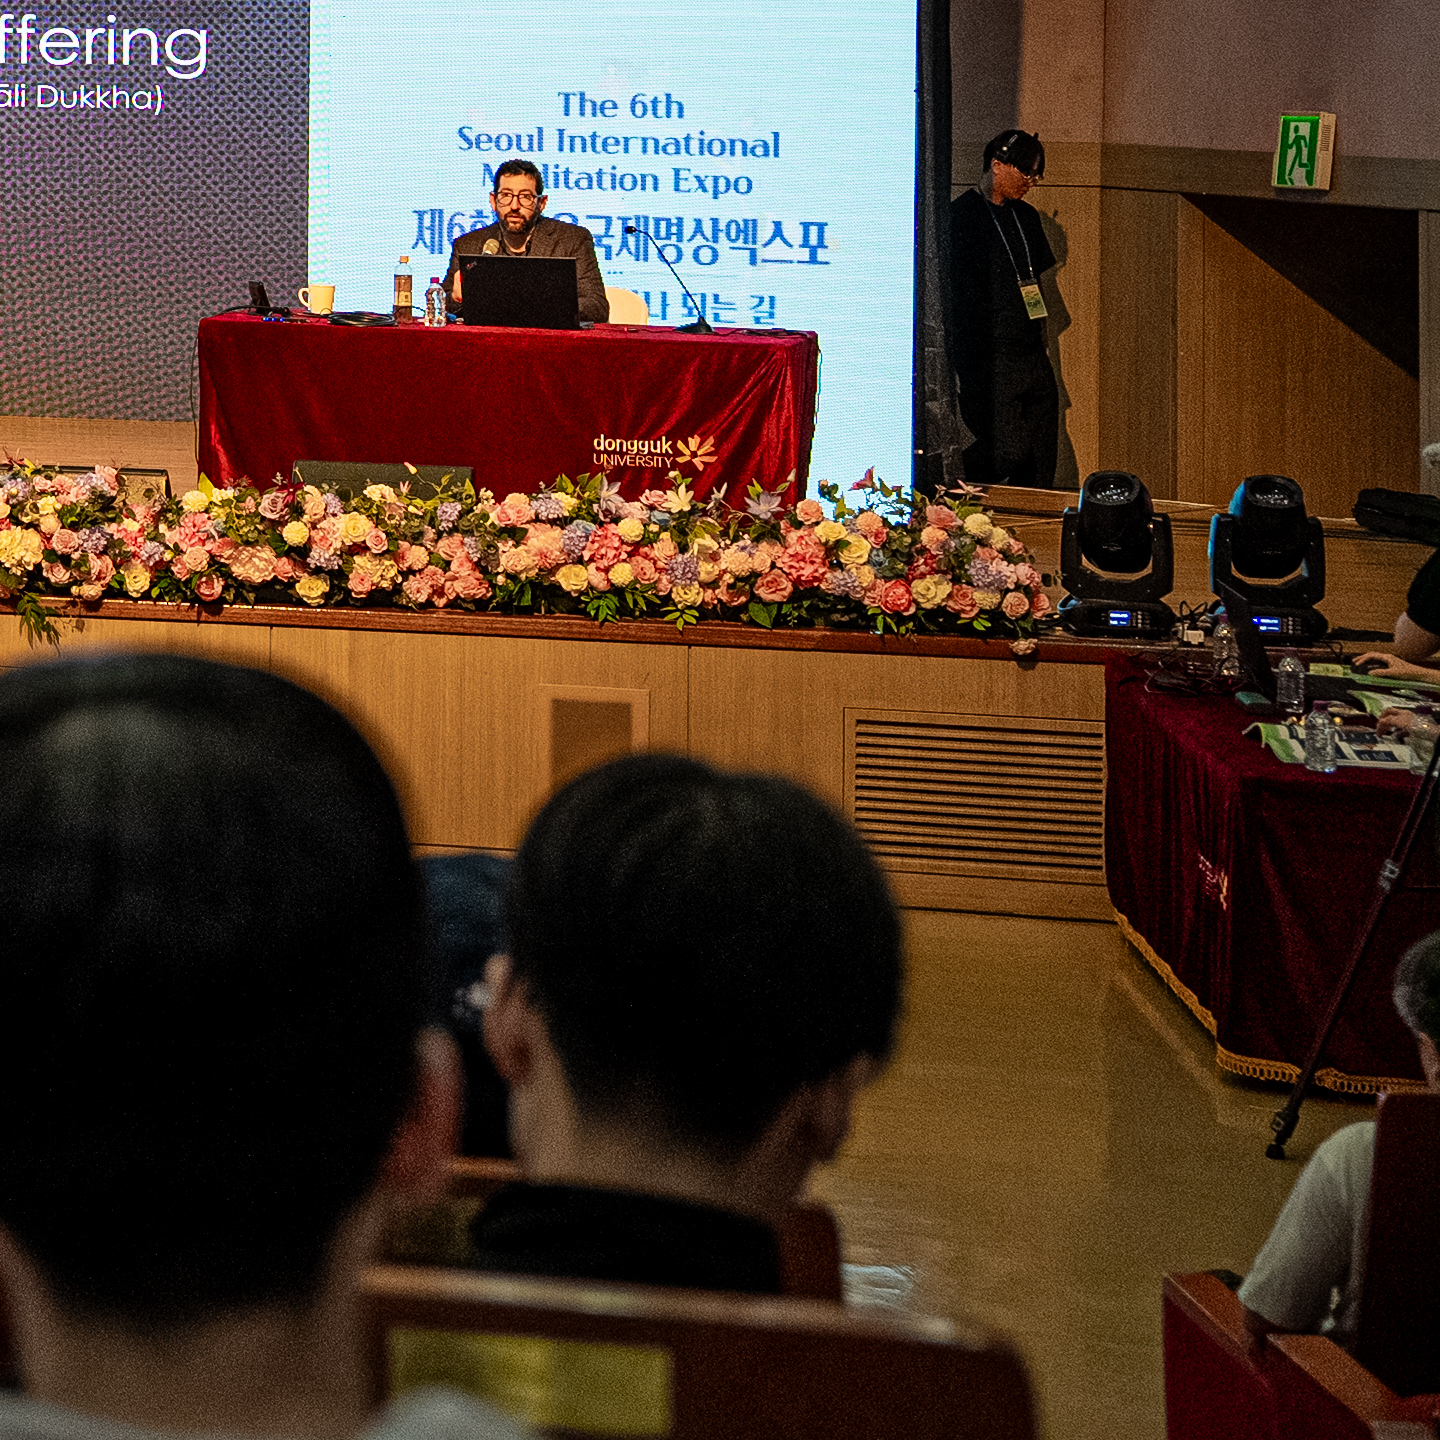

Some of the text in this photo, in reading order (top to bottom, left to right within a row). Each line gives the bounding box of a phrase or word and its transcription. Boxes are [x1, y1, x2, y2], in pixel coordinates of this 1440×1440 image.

[37, 84, 164, 115] Dukkha)
[558, 91, 685, 120] The 6th
[457, 126, 781, 159] Seoul International
[671, 167, 754, 200] Expo
[682, 293, 776, 325] 되는 길
[594, 434, 673, 454] dongguk
[593, 453, 673, 468] UNIVERSITY
